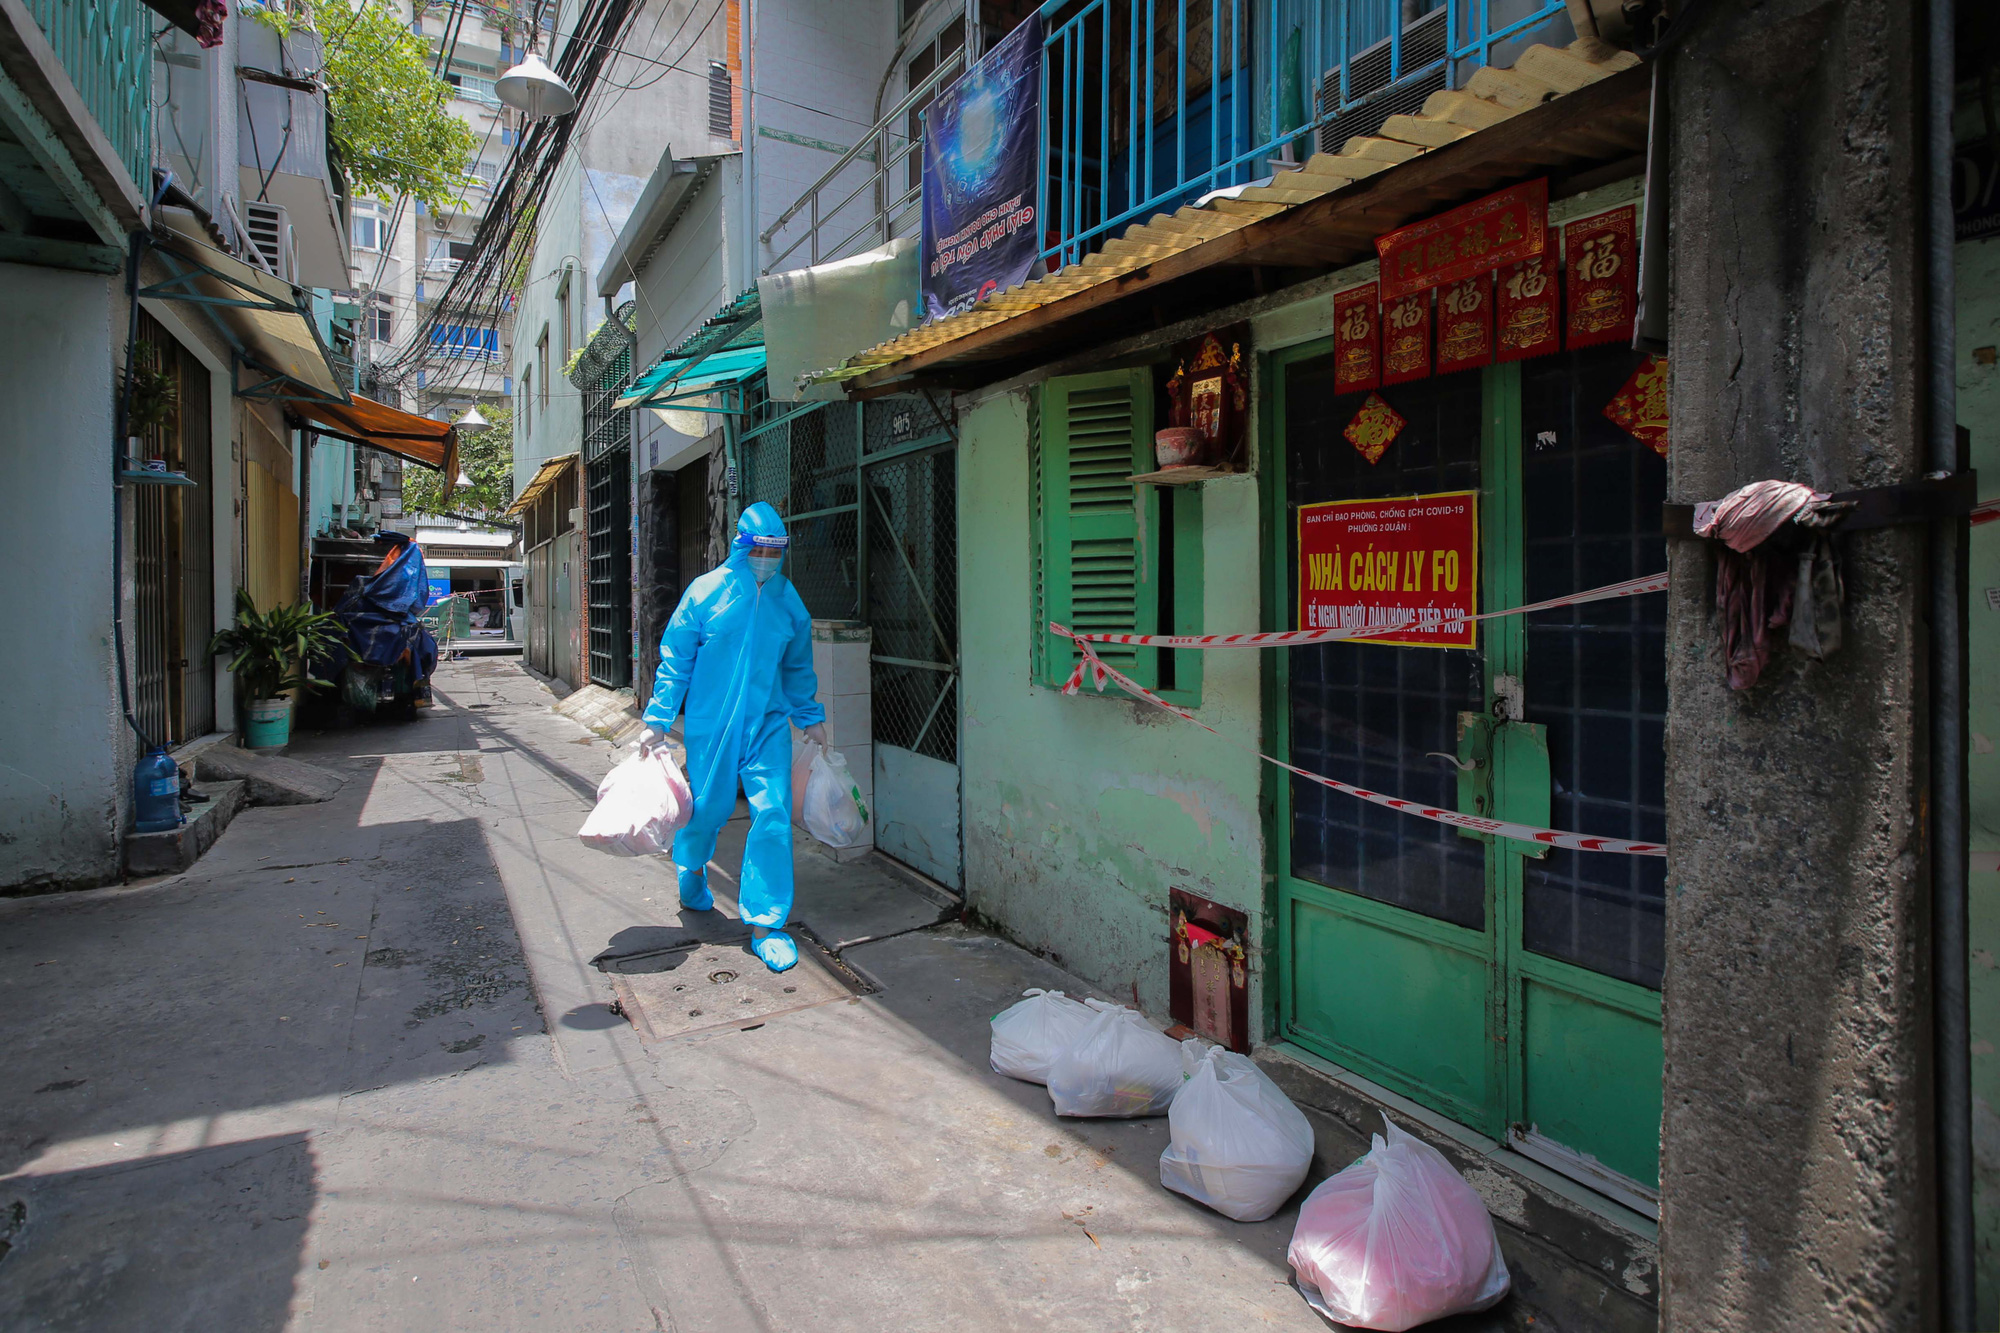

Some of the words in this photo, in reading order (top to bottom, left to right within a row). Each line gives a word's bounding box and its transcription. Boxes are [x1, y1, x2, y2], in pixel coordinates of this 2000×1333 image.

[979, 219, 1006, 250] PHÁP
[957, 237, 979, 264] VỐN
[1576, 233, 1621, 282] 福
[1306, 515, 1321, 523] BAN
[1380, 506, 1405, 518] CHỐNG
[1426, 505, 1464, 516] COVID-19
[1348, 522, 1378, 533] PHƯỜNG
[1385, 520, 1407, 533] QUẬN
[1308, 544, 1343, 590] NHÀ
[1349, 543, 1399, 591] CÁCH
[1403, 550, 1425, 592] LY
